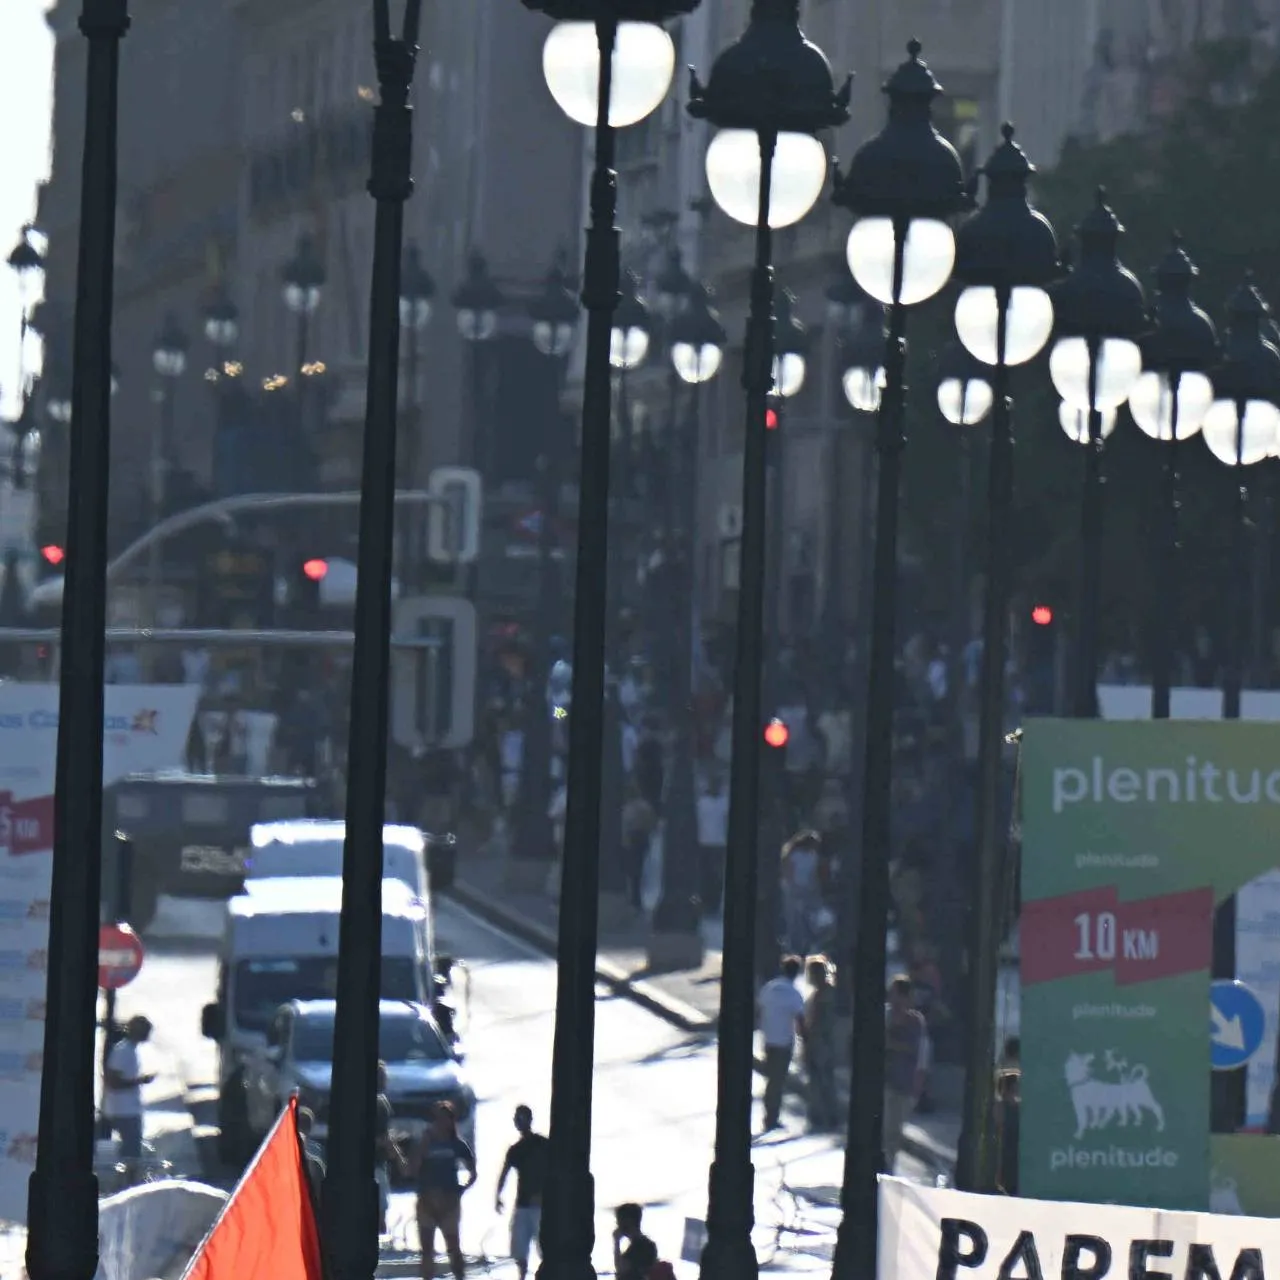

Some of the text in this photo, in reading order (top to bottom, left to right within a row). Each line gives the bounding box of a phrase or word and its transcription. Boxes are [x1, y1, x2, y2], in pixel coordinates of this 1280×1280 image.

[1075, 851, 1159, 868] plenitude
[1073, 911, 1158, 961] 10 KM
[1072, 1002, 1157, 1019] plenitude
[1051, 1145, 1180, 1171] plenitude
